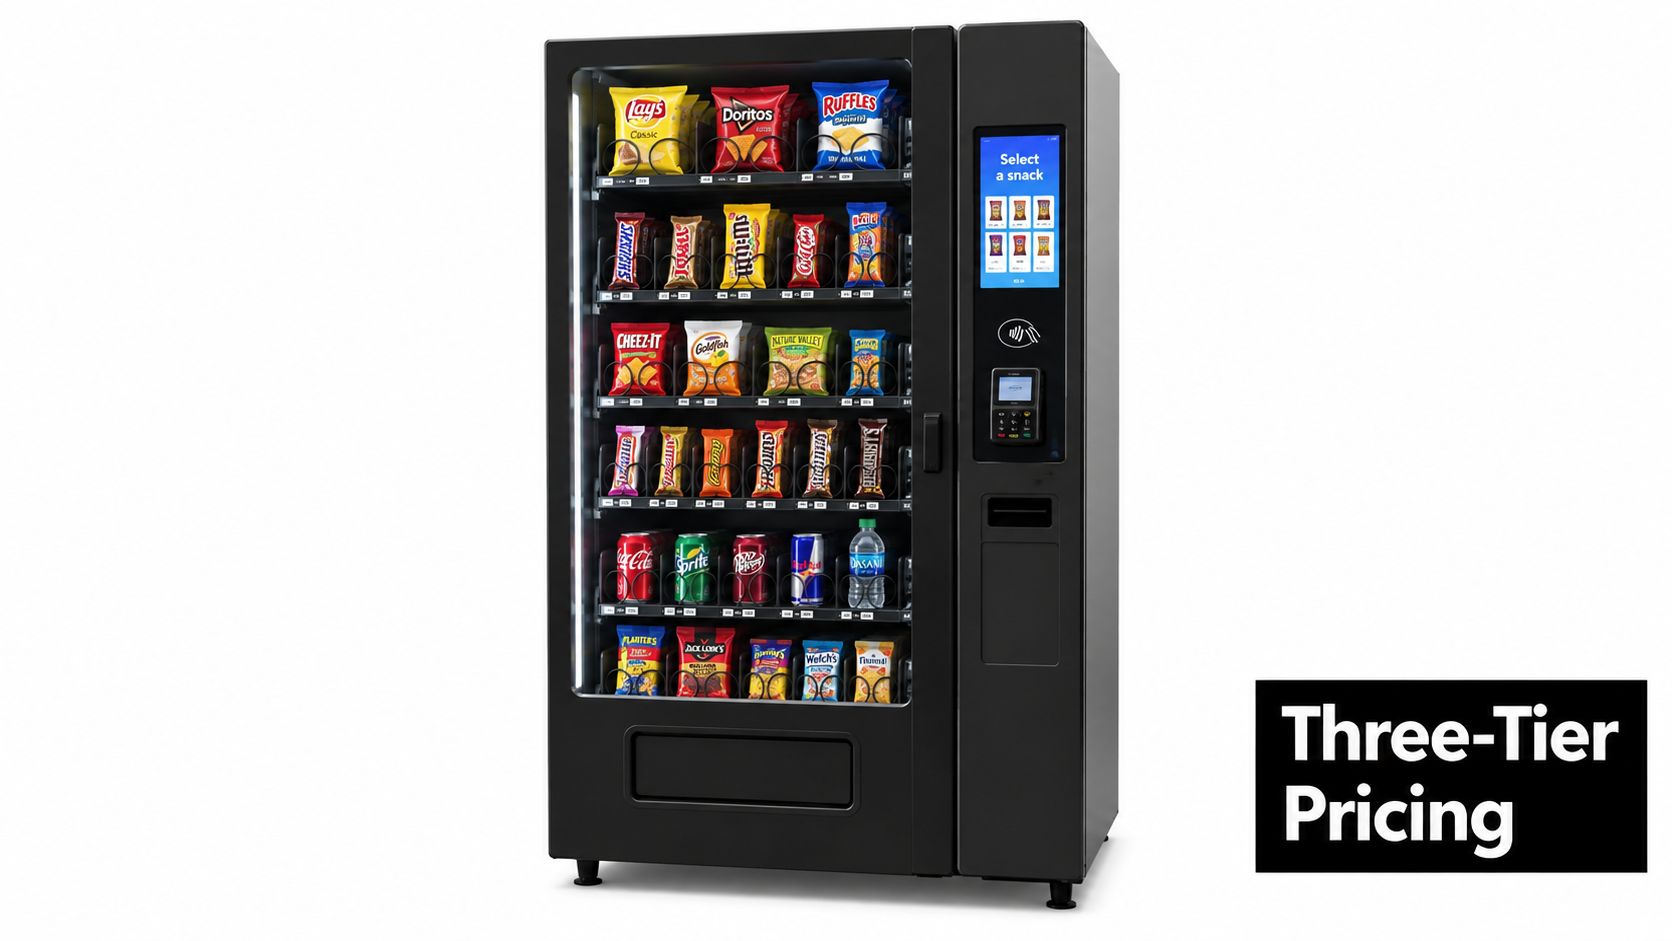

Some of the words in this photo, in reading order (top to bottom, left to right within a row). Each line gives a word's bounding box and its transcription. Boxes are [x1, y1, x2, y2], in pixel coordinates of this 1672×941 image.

[823, 92, 877, 118] RUFFLES
[722, 107, 773, 123] Doritos
[1000, 152, 1040, 165] Select
[995, 172, 1004, 181] a
[1007, 168, 1044, 181] snack
[616, 332, 662, 349] CHEEZ-IT
[676, 554, 709, 573] Sprite
[806, 653, 837, 664] Welch's
